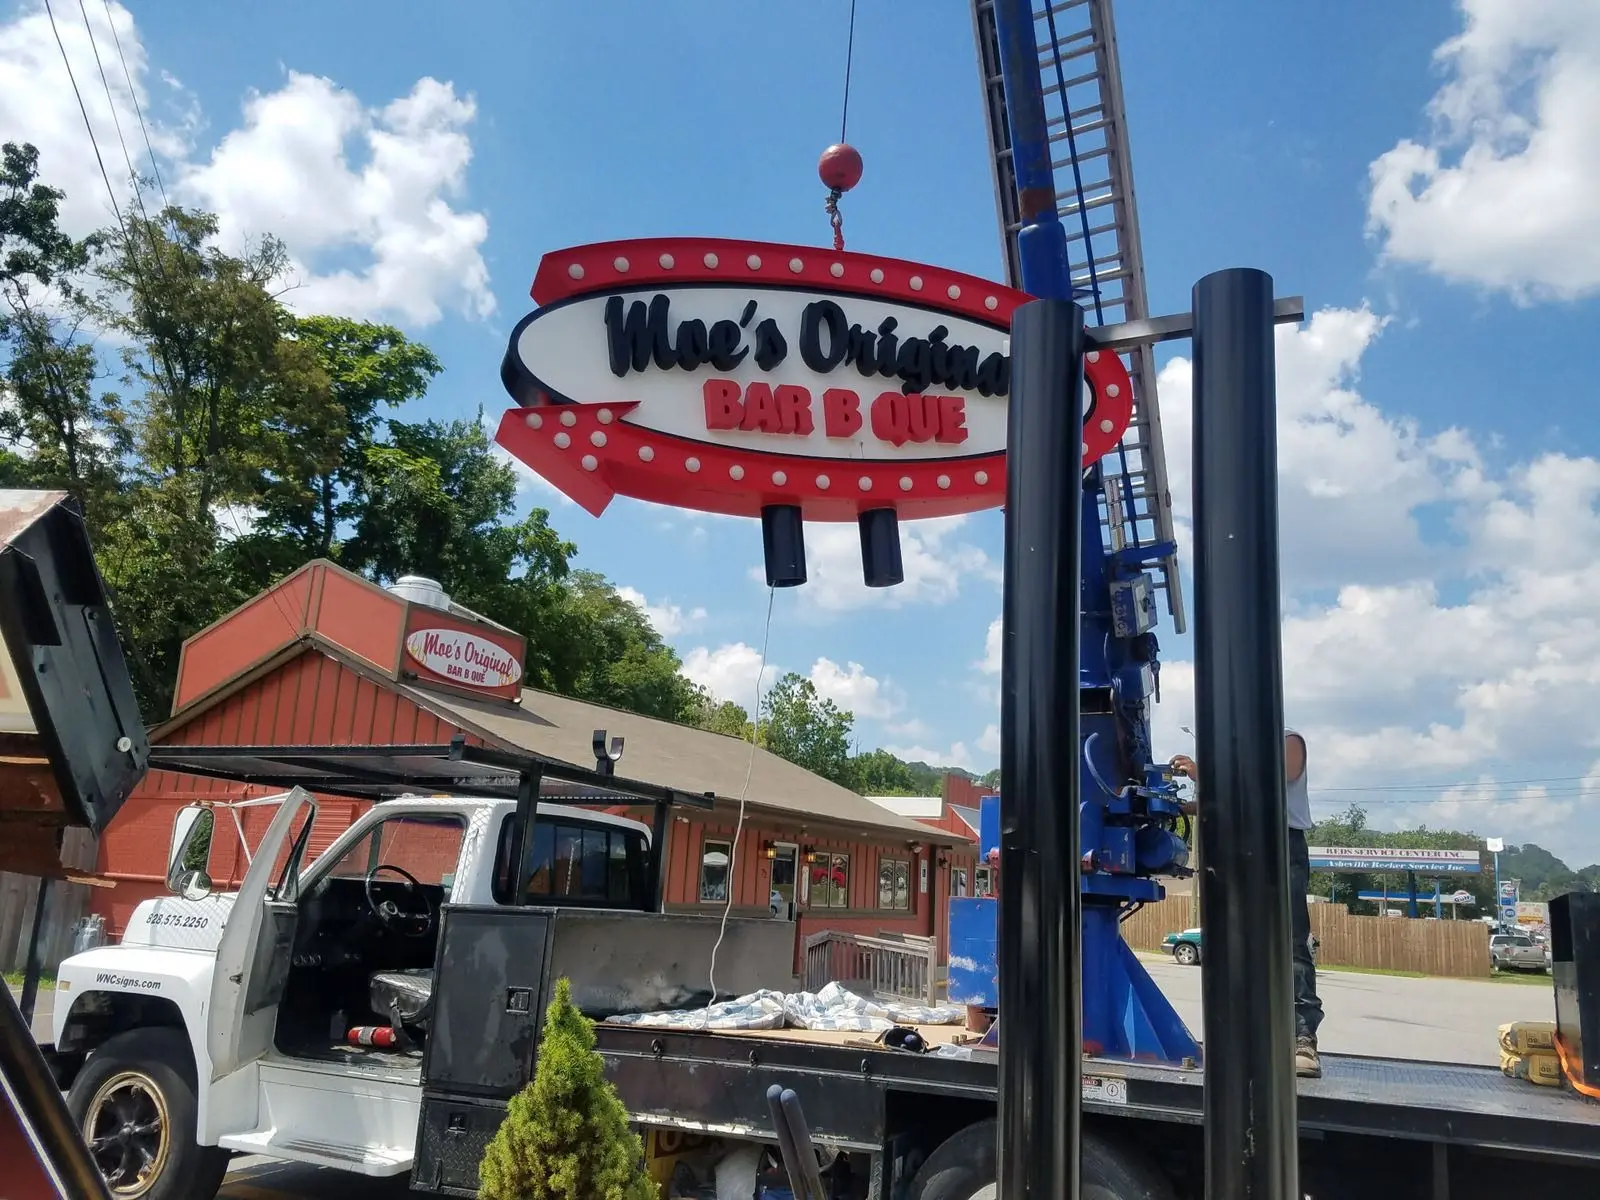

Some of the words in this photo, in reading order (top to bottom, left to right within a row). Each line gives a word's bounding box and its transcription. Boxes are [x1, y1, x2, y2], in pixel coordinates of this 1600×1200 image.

[604, 294, 788, 379] Moe's
[800, 299, 1011, 398] Origina
[703, 378, 814, 437] BAR
[823, 388, 863, 439] B
[870, 393, 968, 448] QUE
[424, 632, 461, 660] Moe's
[464, 641, 513, 677] Original
[447, 664, 462, 677] BAR
[464, 670, 470, 679] B
[471, 671, 486, 683] QUE
[1327, 860, 1368, 868] Asheville
[146, 912, 209, 929] 828.575.2250
[96, 972, 162, 990] WNCsigns.com
